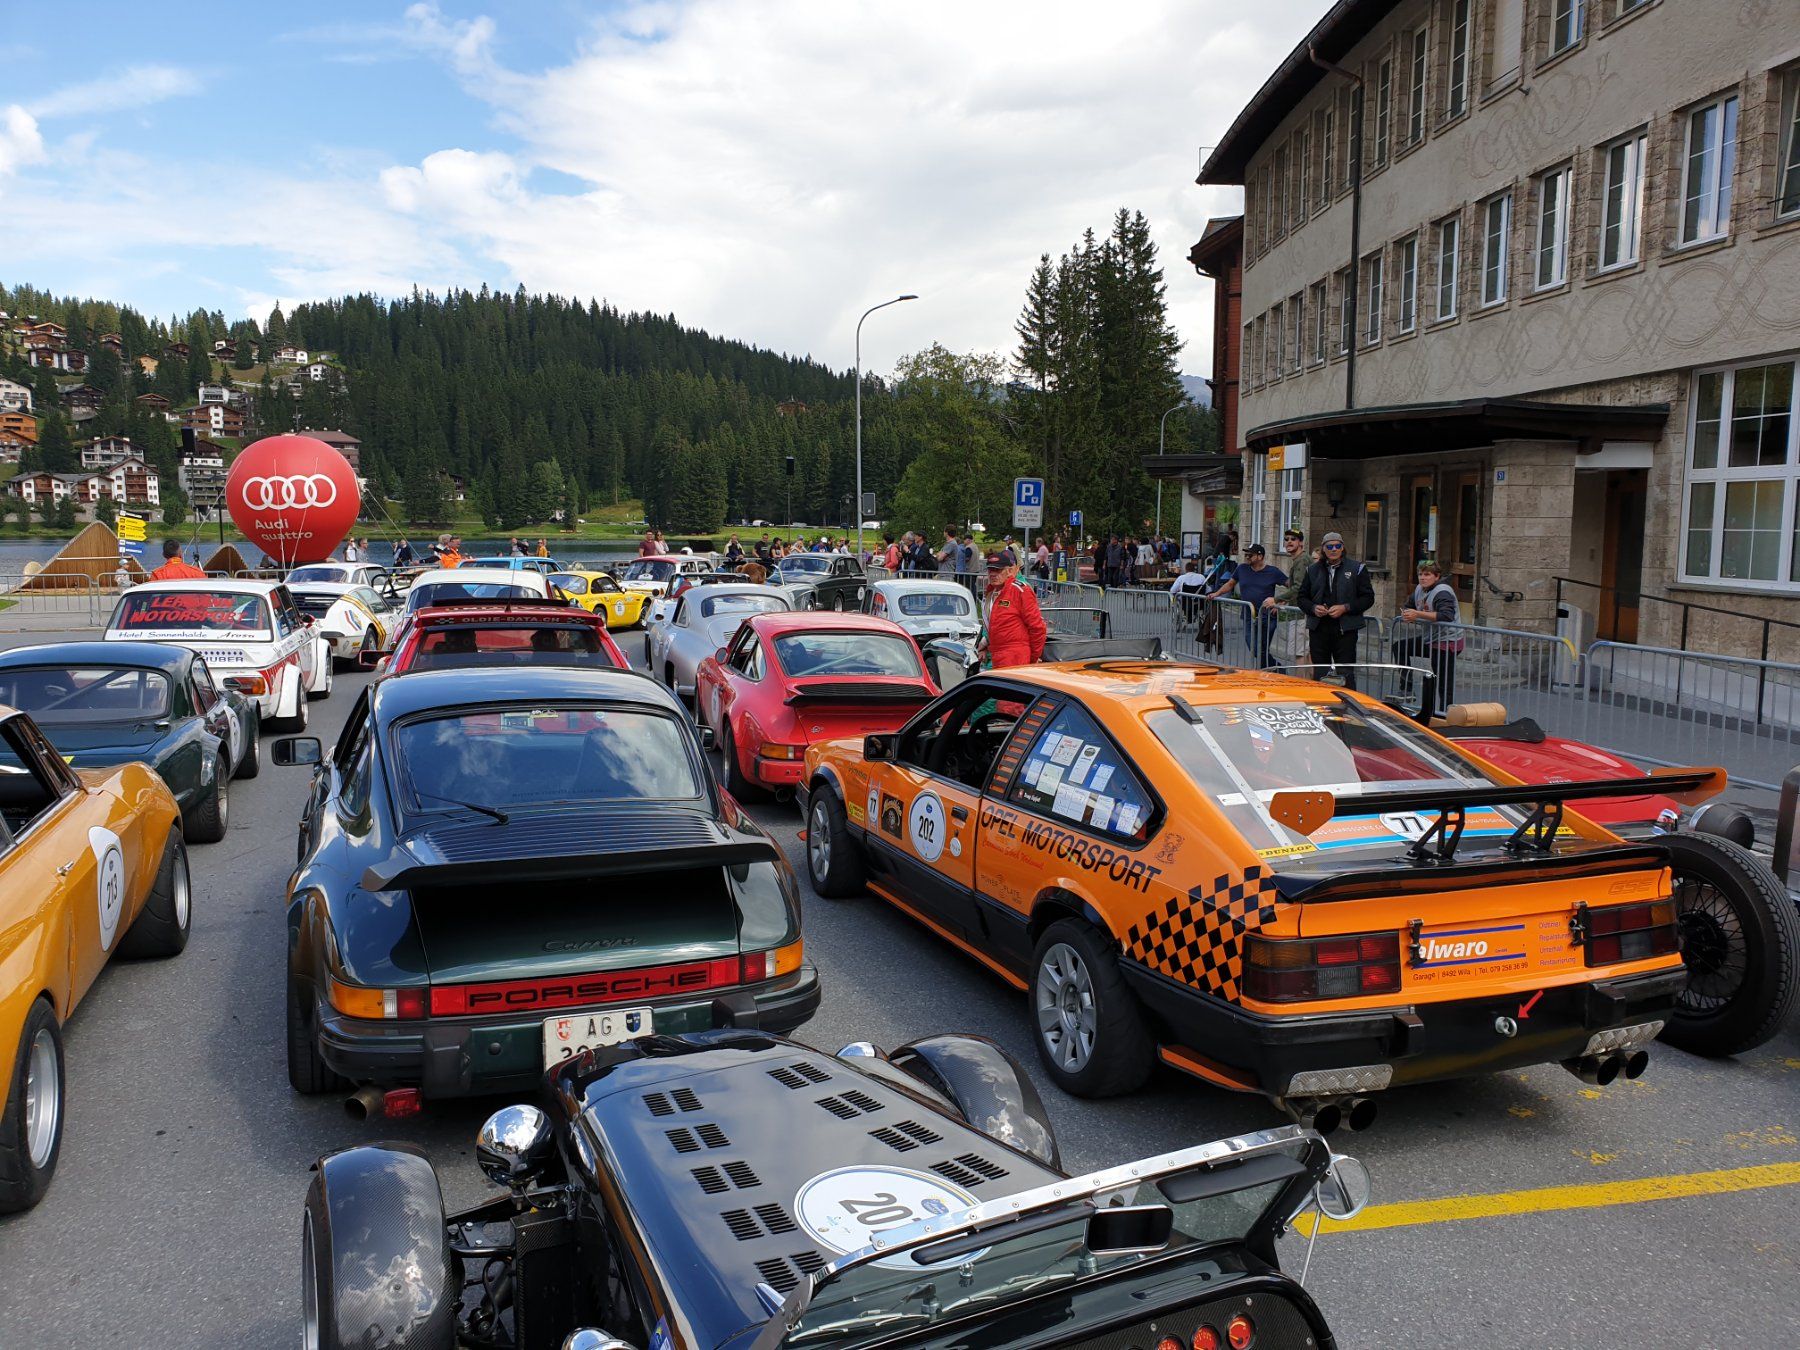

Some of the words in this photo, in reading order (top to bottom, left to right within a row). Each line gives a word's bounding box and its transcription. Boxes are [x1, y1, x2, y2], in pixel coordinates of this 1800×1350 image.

[1021, 483, 1034, 503] P
[255, 518, 289, 529] Audi
[261, 531, 313, 541] quattro
[130, 609, 248, 623] MOTORSPORT
[118, 630, 143, 638] Hotel
[217, 631, 256, 639] Arosa
[1258, 706, 1307, 722] Show
[870, 797, 877, 814] 77
[918, 815, 935, 844] 202
[981, 804, 1016, 839] OPEL
[1021, 819, 1162, 894] MOTORSPORT
[1266, 844, 1313, 856] DUNLOP
[543, 935, 641, 951] Carrera
[1412, 972, 1436, 981] Garage
[469, 969, 708, 1007] PORSCHE
[587, 1015, 613, 1038] AG
[838, 1192, 922, 1234] 20
